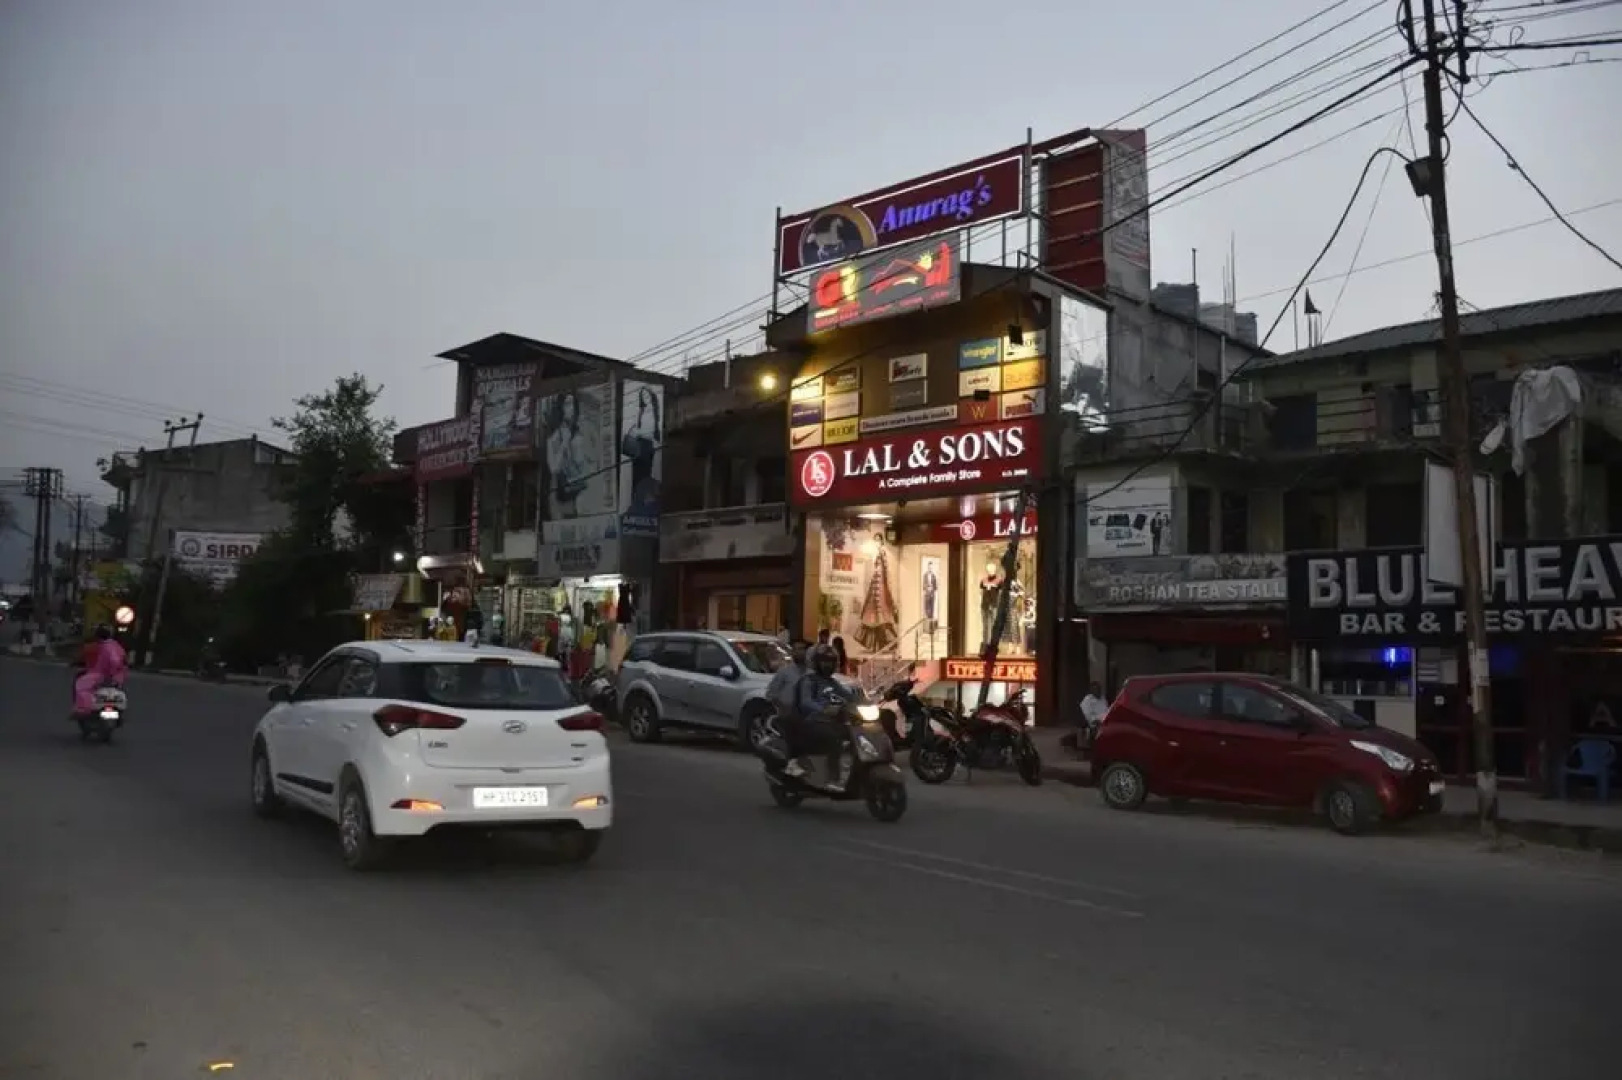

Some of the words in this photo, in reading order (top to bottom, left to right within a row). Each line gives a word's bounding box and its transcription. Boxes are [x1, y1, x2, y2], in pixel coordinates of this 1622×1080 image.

[878, 175, 991, 233] Anurag's
[843, 443, 901, 477] LAL
[907, 439, 931, 468] &
[938, 426, 1025, 465] SONS
[886, 475, 928, 488] Complete
[929, 471, 957, 484] Family
[958, 469, 981, 480] Store
[1186, 584, 1221, 600] TEA
[1225, 582, 1285, 599] STALL
[1482, 542, 1622, 603] HEA
[1339, 612, 1407, 636] BAR
[1417, 611, 1442, 634] &
